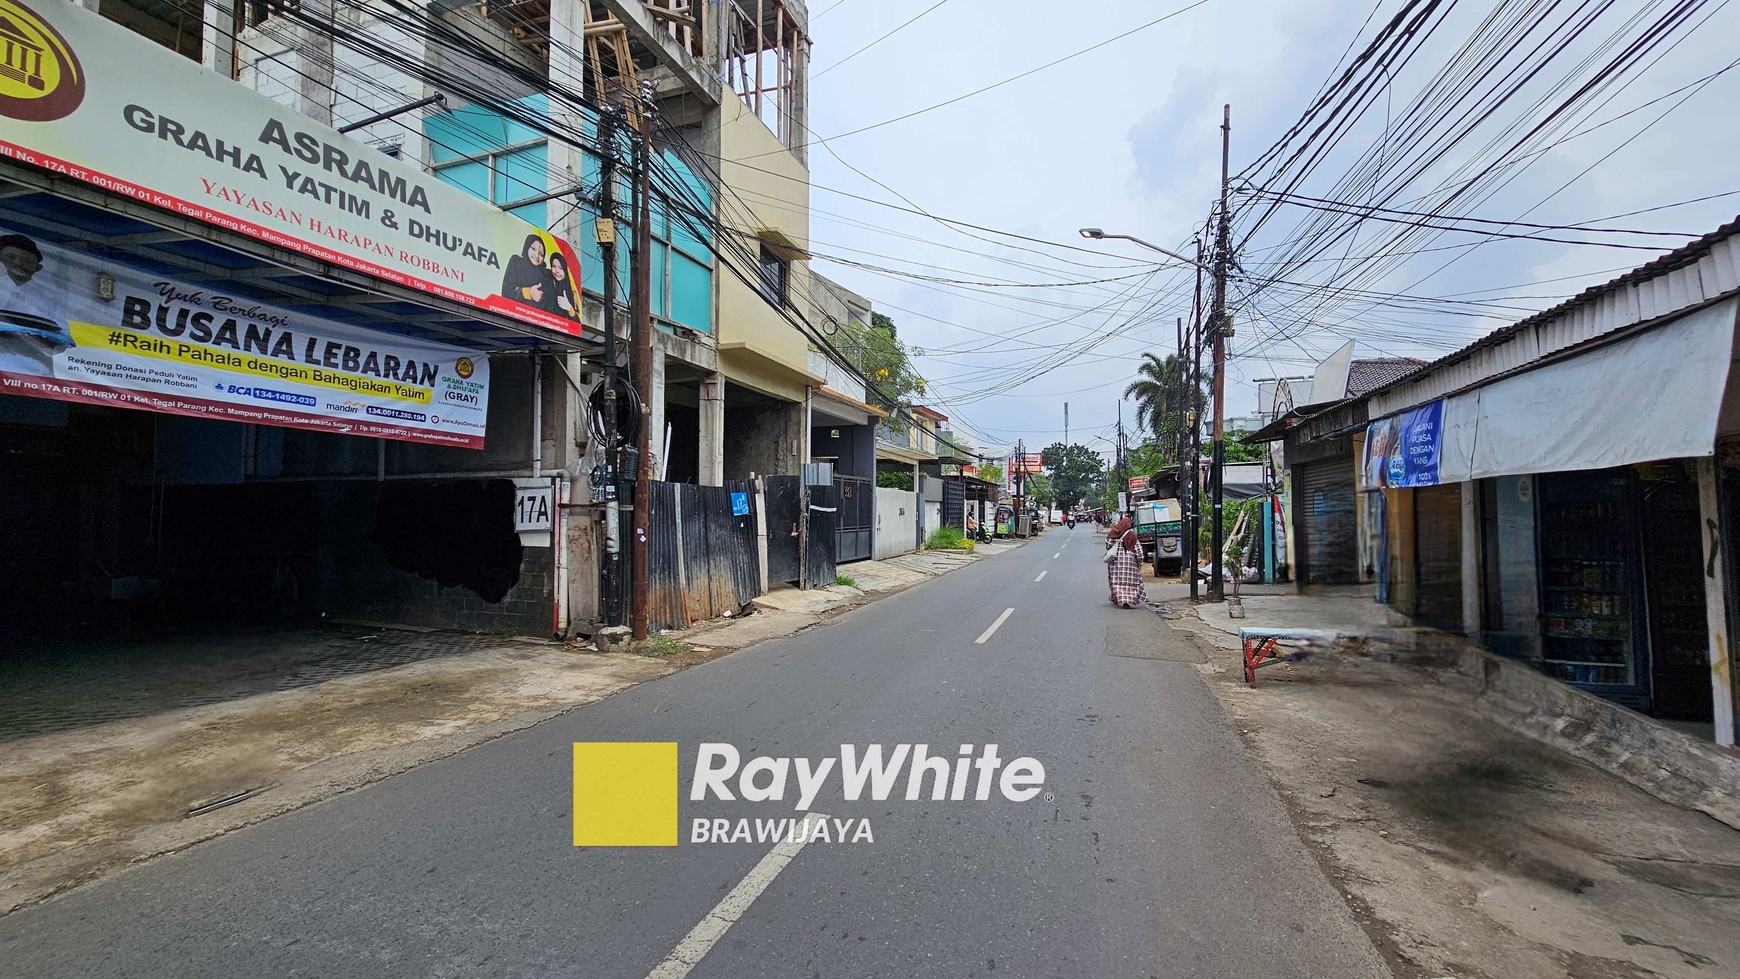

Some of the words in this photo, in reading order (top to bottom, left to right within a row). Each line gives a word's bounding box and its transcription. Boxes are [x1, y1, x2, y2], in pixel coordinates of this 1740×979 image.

[123, 104, 268, 180] GRAHA
[277, 164, 370, 220] YATIM
[380, 208, 399, 231] &
[408, 218, 500, 270] DHU'AFA
[258, 118, 432, 215] ASRAMA
[16, 150, 38, 165] No.
[43, 160, 67, 174] 17A
[70, 168, 89, 181] RT.
[92, 175, 136, 196] 001/RW
[138, 188, 150, 200] 01
[154, 195, 174, 209] Kel.
[176, 202, 203, 217] Tegal
[205, 211, 238, 231] Parang
[239, 223, 259, 237] Kec.
[261, 230, 301, 251] Mampang
[302, 244, 336, 261] Prapatan
[337, 256, 354, 267] Kota
[355, 262, 380, 275] Jakarta
[380, 269, 404, 282] Selatan
[200, 177, 302, 226] YAYASAN
[308, 217, 394, 258] HARAPAN
[399, 250, 465, 282] ROBBANI
[153, 281, 203, 308] Yuk
[210, 296, 288, 328] Berbagi
[121, 295, 296, 361] BUSANA
[305, 337, 439, 388] LEBARAN
[67, 356, 113, 370] Rekening
[115, 364, 146, 374] Donasi
[149, 368, 175, 378] Peduli
[176, 373, 198, 382] Yatim
[84, 366, 123, 378] Yayasan
[125, 372, 162, 384] Harapan
[164, 379, 197, 389] Robbani
[108, 331, 171, 355] #Raih
[178, 344, 242, 367] Pahala
[247, 358, 308, 379] dengan
[313, 370, 391, 394] Bahagiakan
[394, 385, 425, 400] Yatim
[3, 378, 21, 387] VIII
[40, 383, 61, 393] 17A
[63, 386, 79, 395] RT.
[81, 389, 118, 400] 001/RW
[133, 396, 151, 404] Kel.
[152, 398, 176, 408] Tegal
[177, 402, 206, 412] Parang
[208, 405, 226, 414] Kec.
[227, 407, 262, 418] Mampang
[263, 412, 293, 422] Prapatan
[227, 385, 251, 396] BCA
[254, 389, 315, 405] 134-1492-039
[444, 390, 478, 406] (GRAY)
[1409, 444, 1435, 455] DENGAN
[518, 495, 549, 523] 17A
